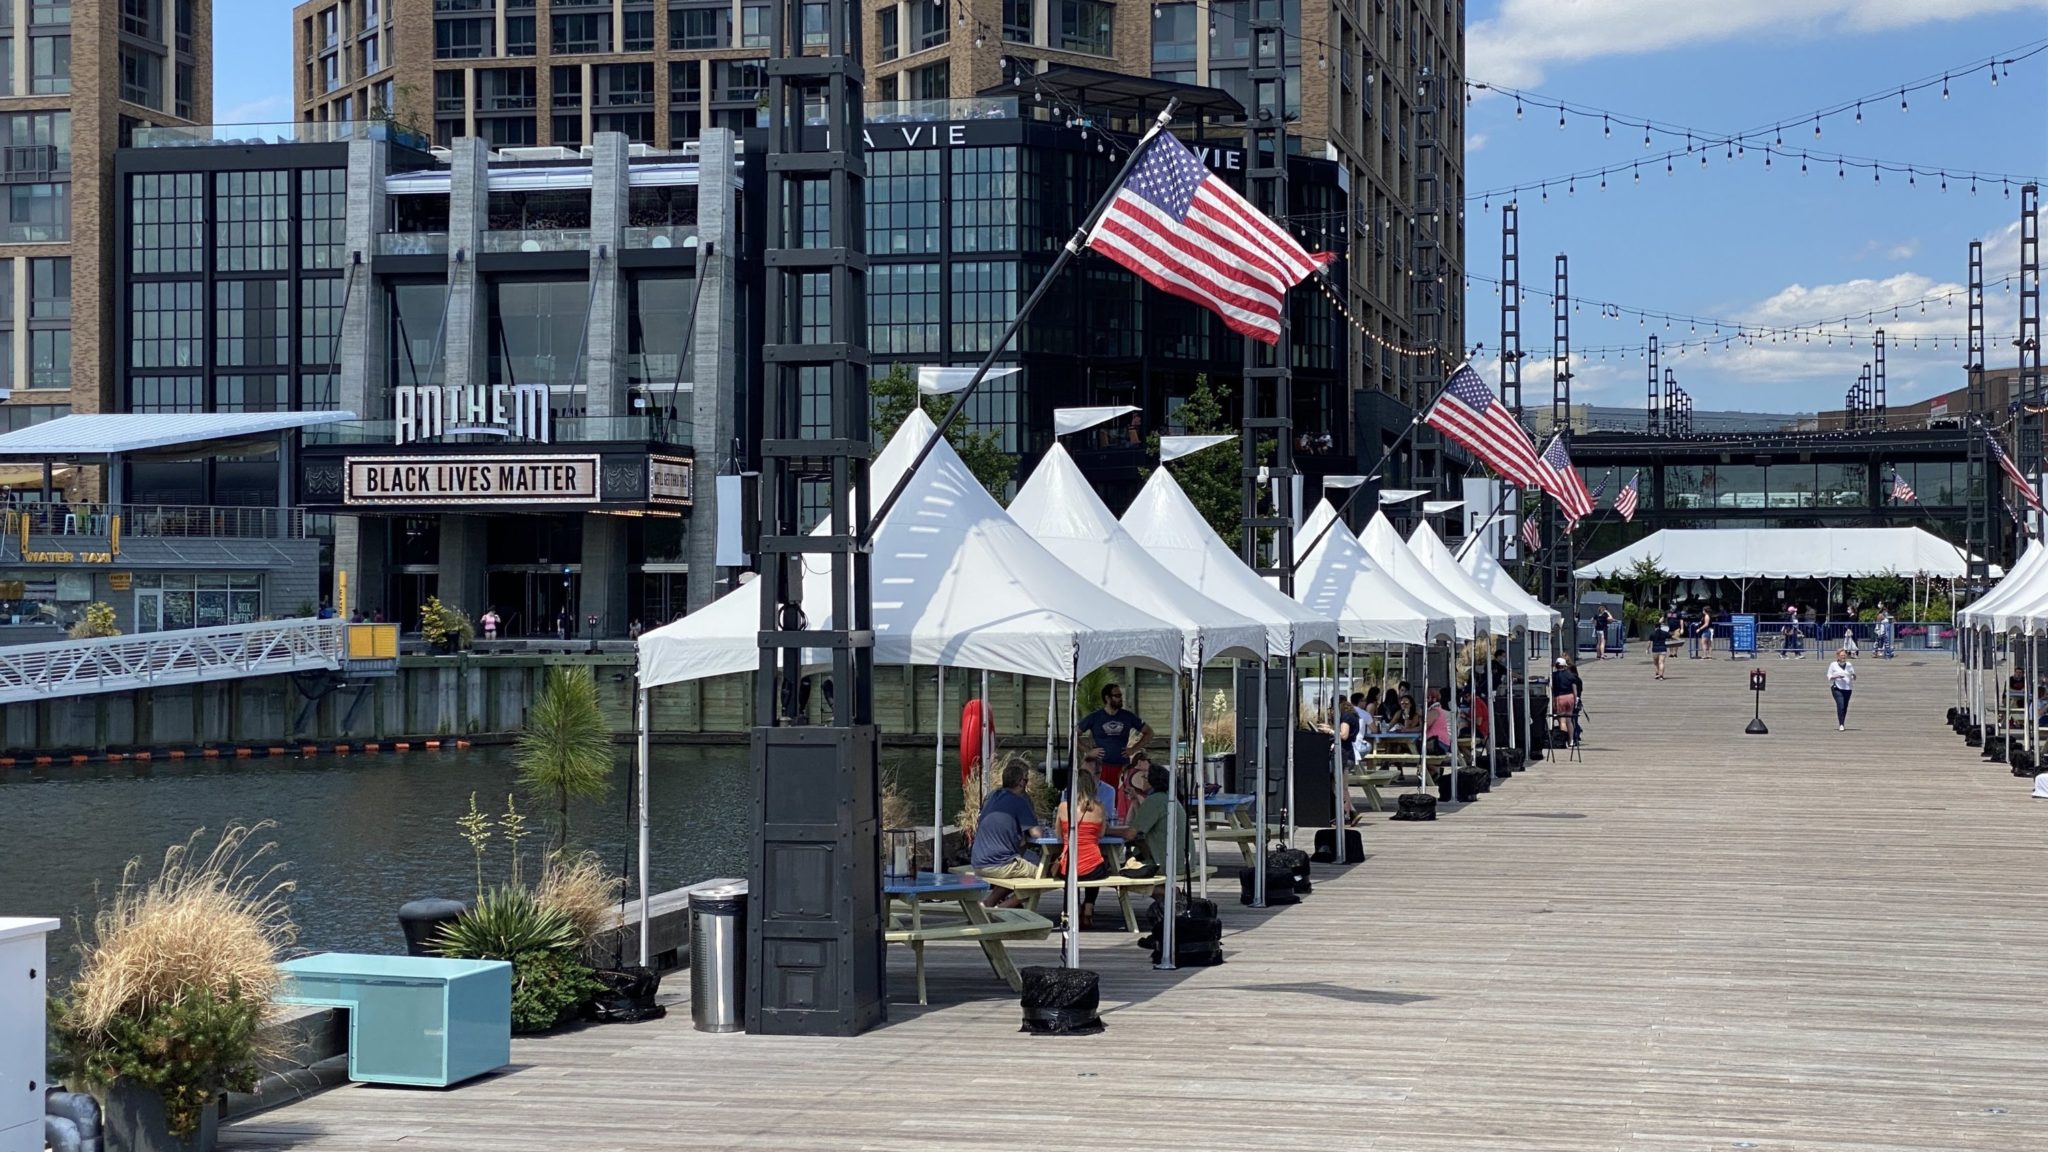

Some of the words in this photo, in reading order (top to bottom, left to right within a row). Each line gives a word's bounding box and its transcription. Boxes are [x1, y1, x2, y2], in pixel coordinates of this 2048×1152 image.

[901, 125, 966, 147] VIE
[1193, 146, 1240, 170] VIE
[395, 383, 549, 446] ANTHEM
[366, 466, 430, 492] BLACK
[437, 465, 491, 491] LIVES
[499, 463, 577, 491] MATTER
[25, 552, 74, 563] WATER
[80, 552, 112, 563] TAXI
